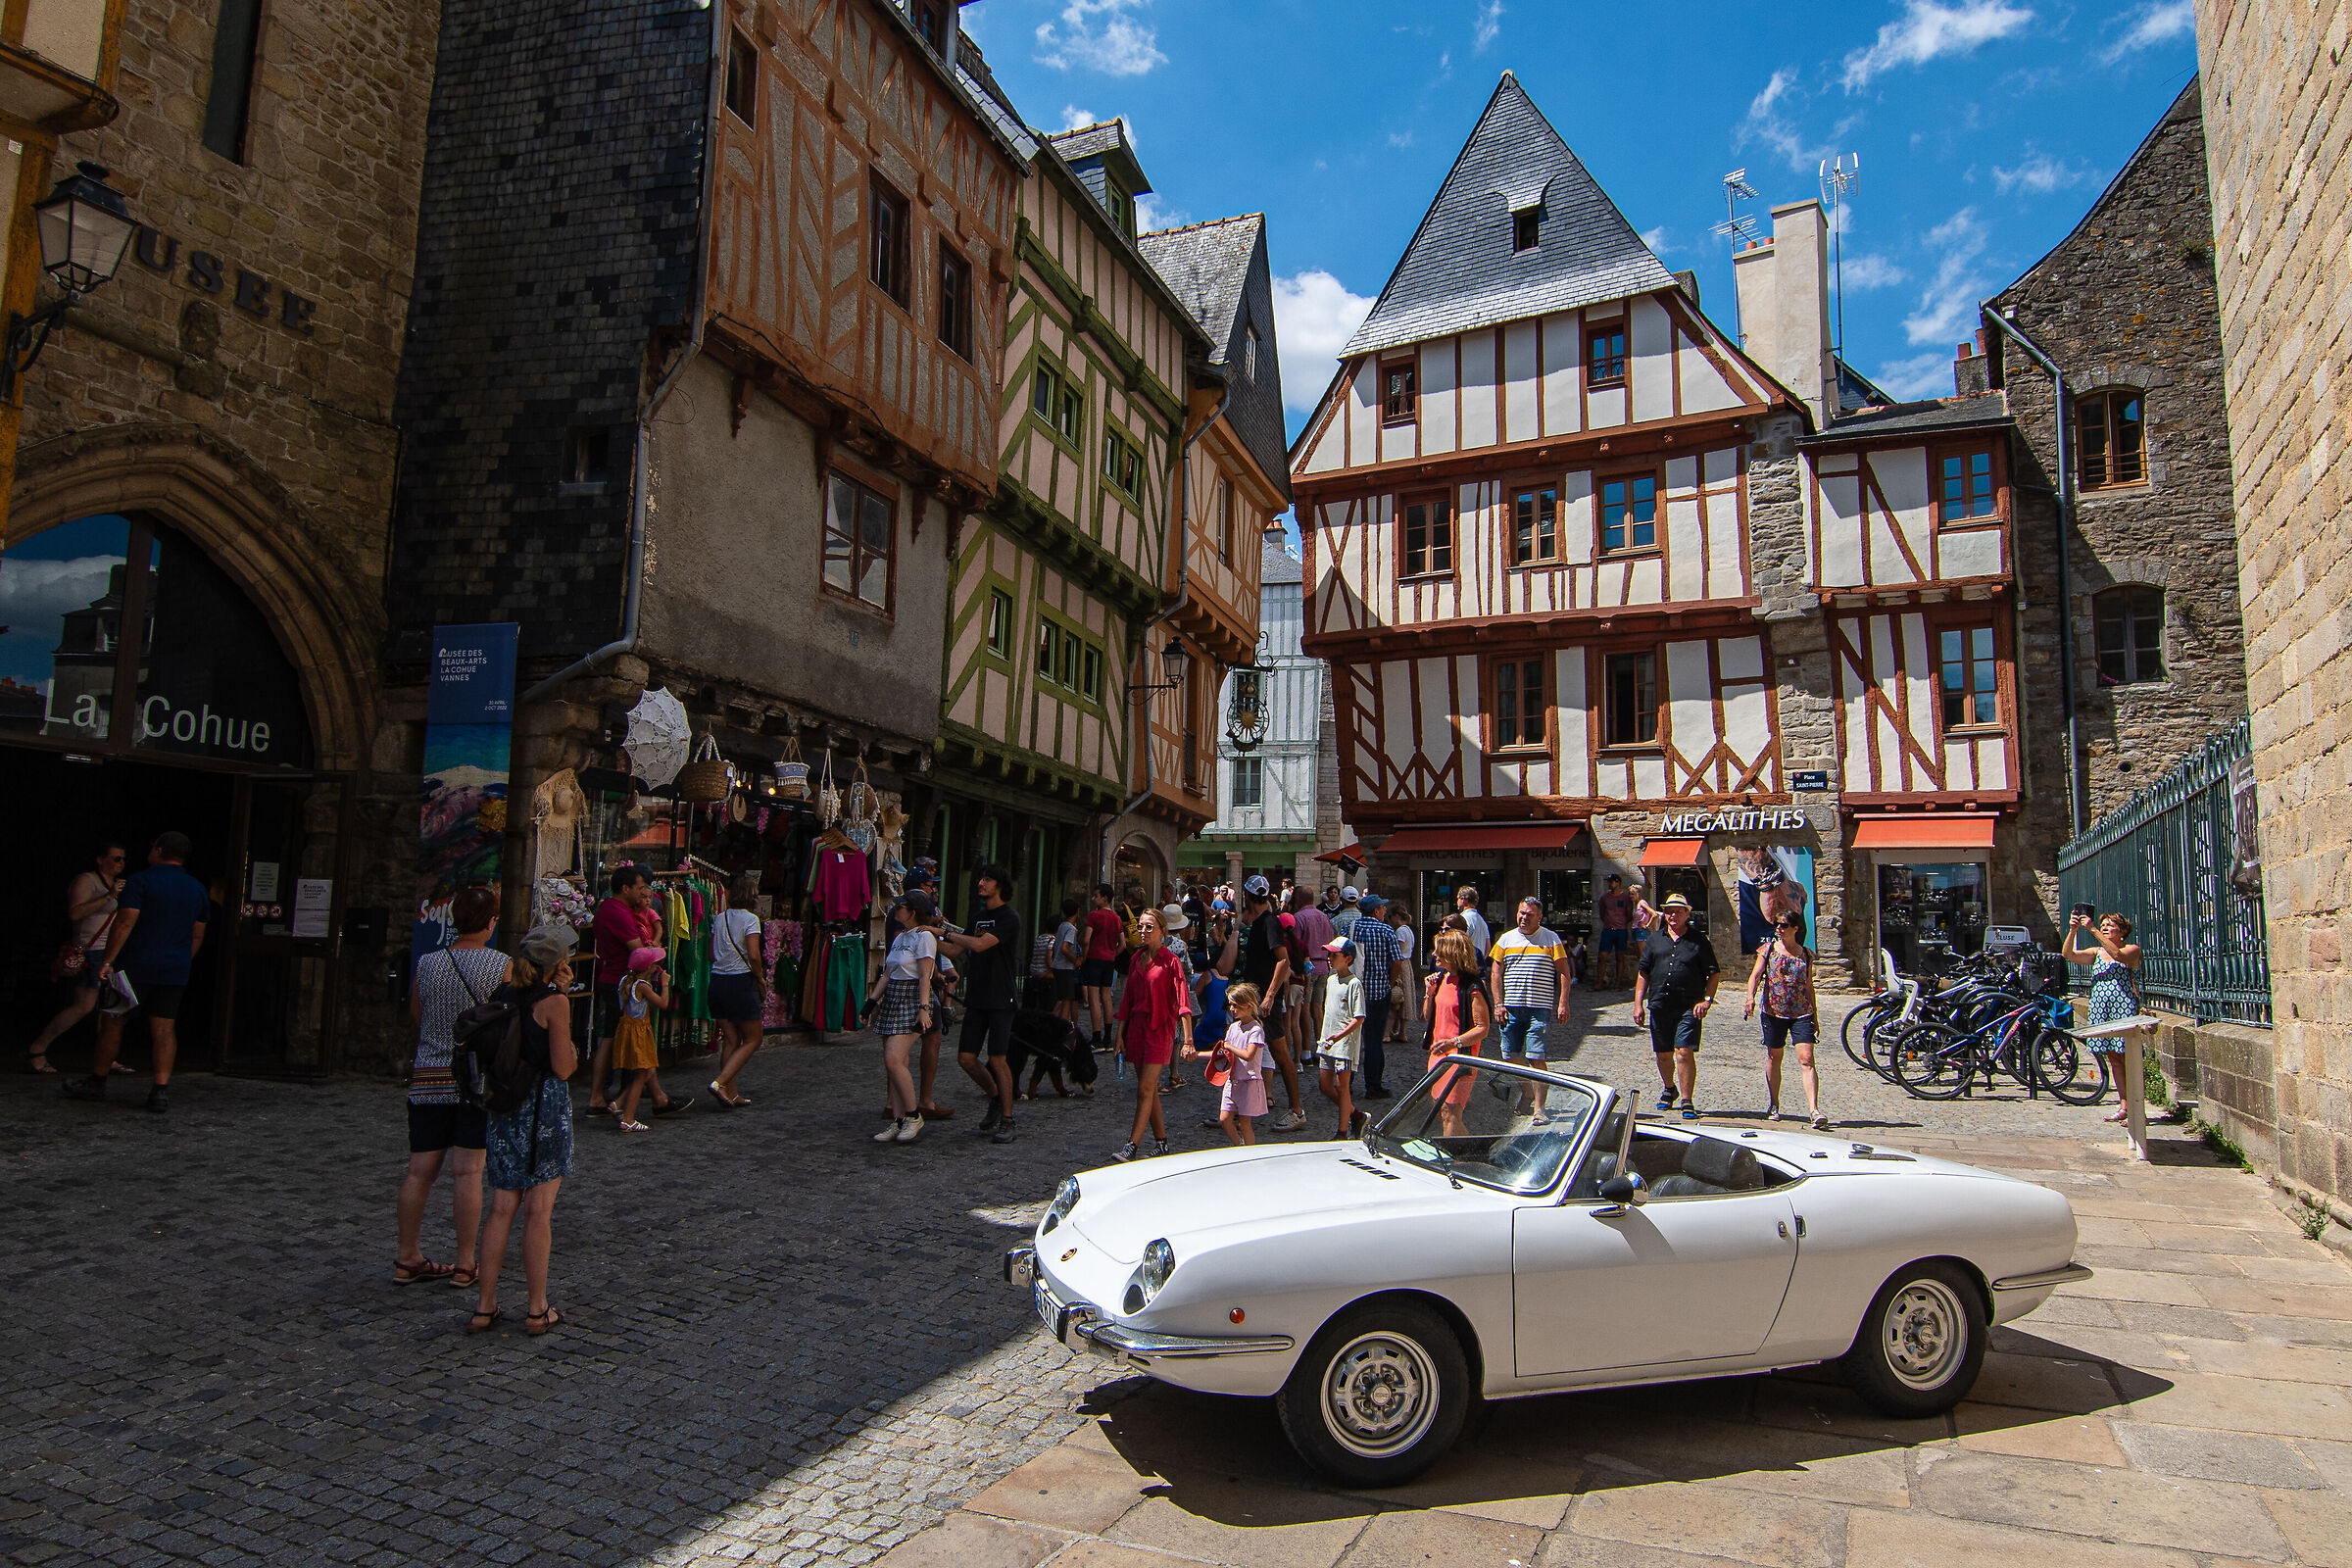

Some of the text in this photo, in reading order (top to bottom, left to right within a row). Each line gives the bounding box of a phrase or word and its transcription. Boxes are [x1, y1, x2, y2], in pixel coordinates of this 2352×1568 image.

[136, 225, 317, 336] USEE
[441, 657, 487, 665] BEAUX-ARTS
[467, 649, 483, 658] DES
[440, 673, 470, 682] VANNES
[44, 678, 271, 752] La Cohue
[1660, 808, 1806, 833] MEGALITHES
[1531, 847, 1591, 862] Bijouterie
